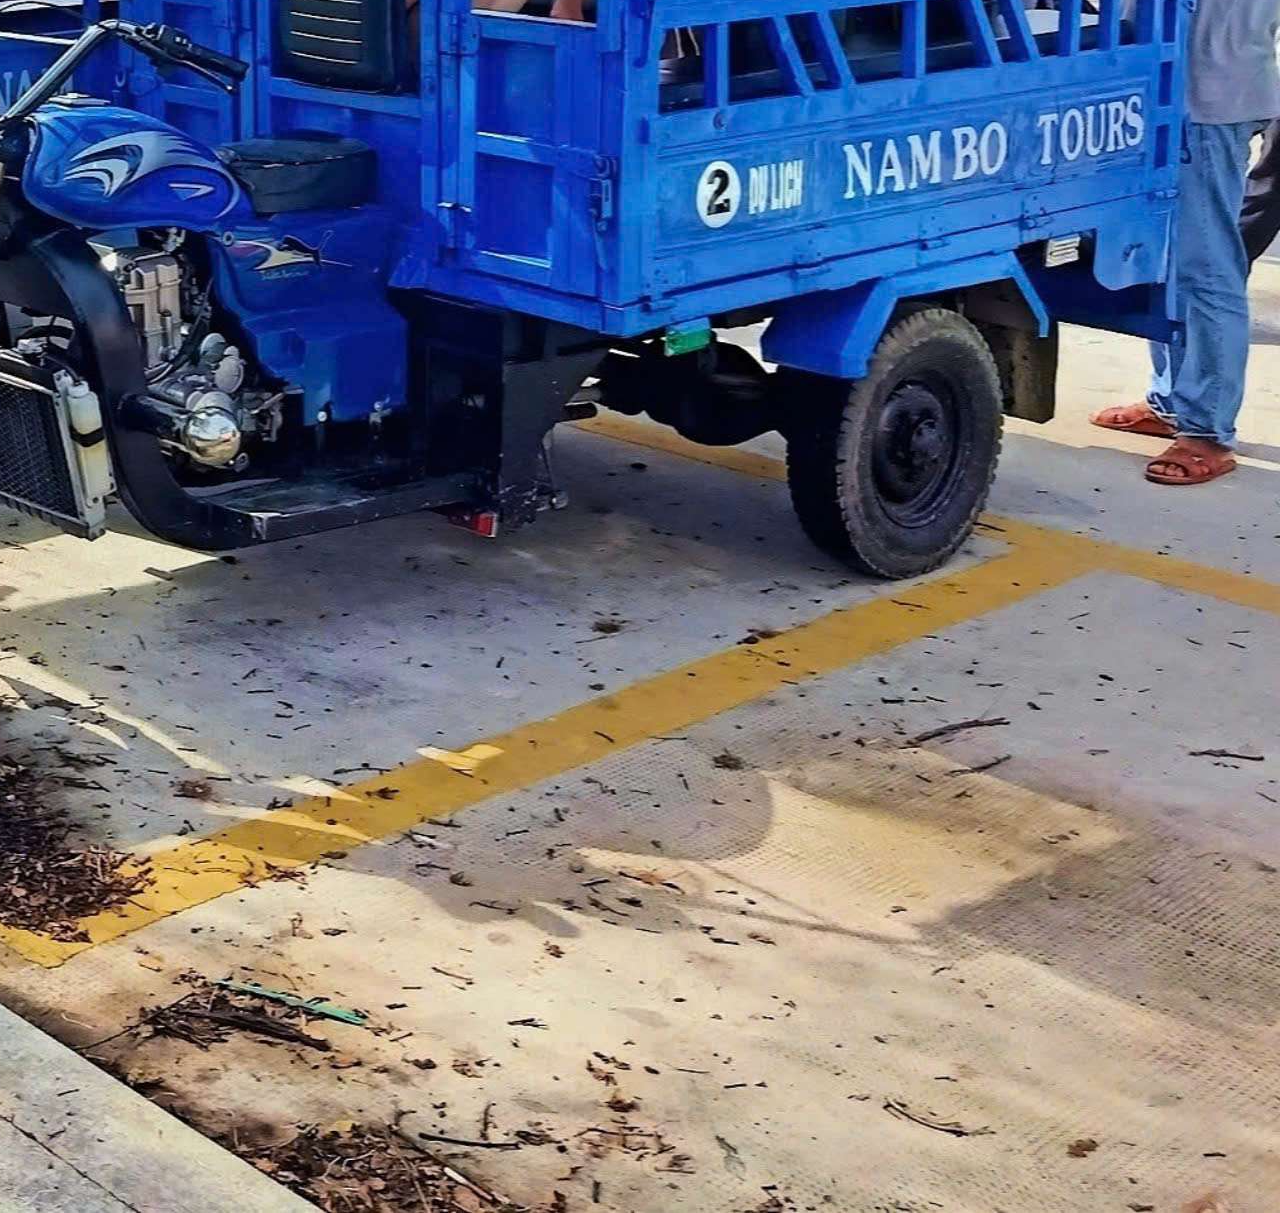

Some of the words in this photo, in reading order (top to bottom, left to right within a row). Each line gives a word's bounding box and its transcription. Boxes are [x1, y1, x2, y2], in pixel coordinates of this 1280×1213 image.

[843, 131, 941, 199] NAM
[952, 122, 1007, 180] BO
[1037, 95, 1144, 165] TOURS
[707, 169, 730, 215] 2
